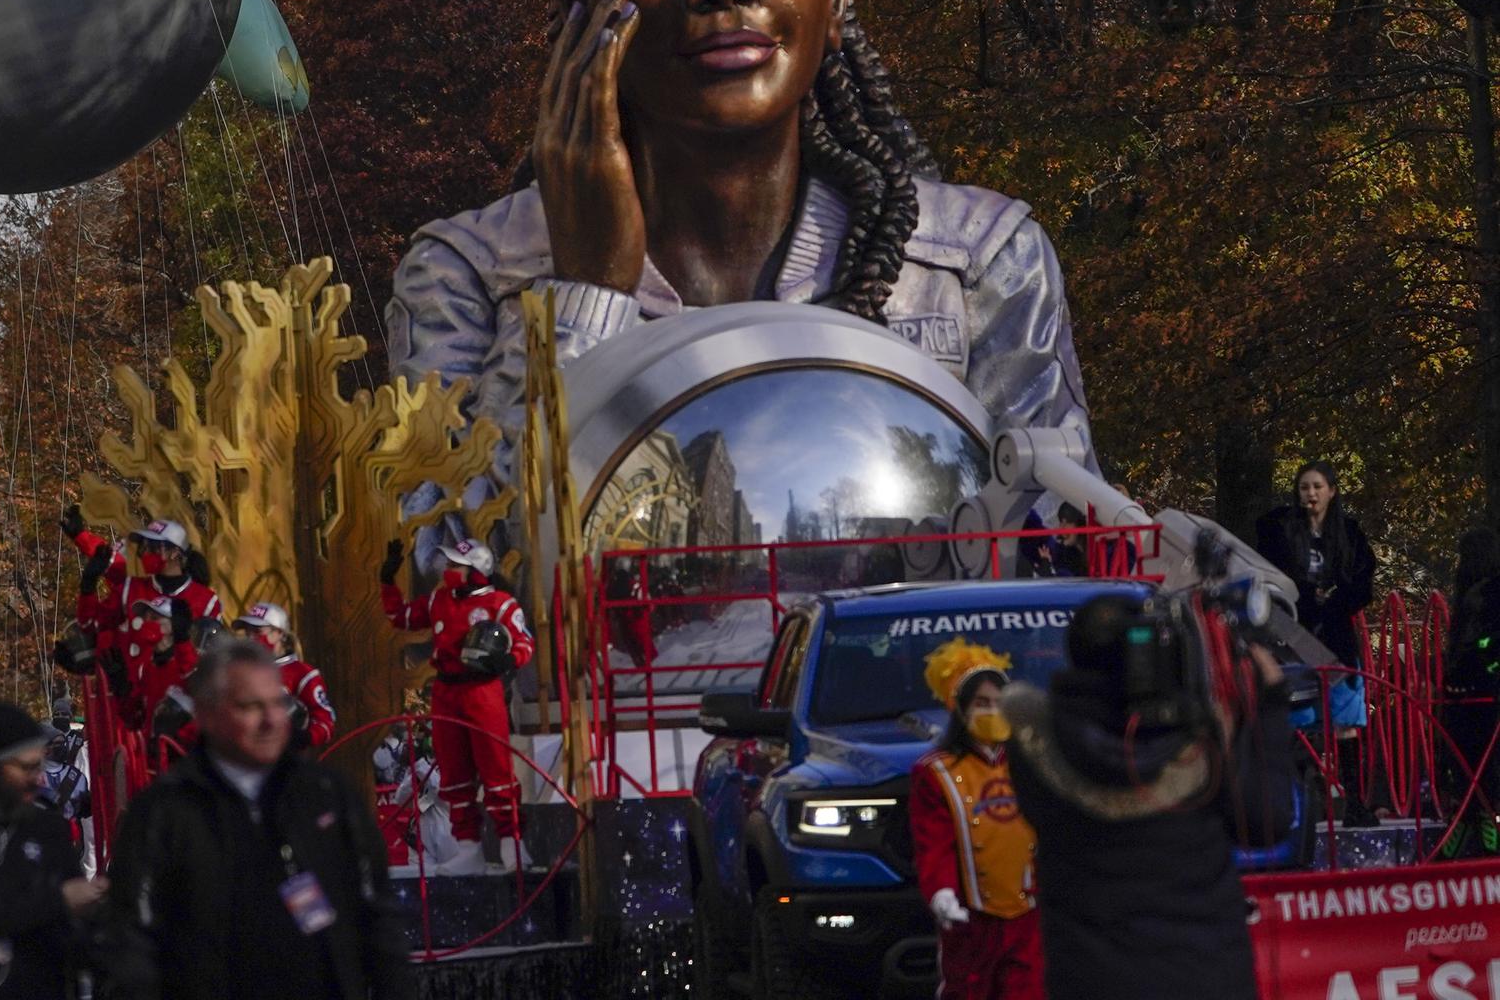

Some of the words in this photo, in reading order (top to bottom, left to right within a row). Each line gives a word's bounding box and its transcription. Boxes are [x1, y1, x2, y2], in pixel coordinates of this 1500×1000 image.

[889, 610, 1076, 637] #RAMTRUC
[1275, 876, 1500, 922] THANKSGIVIN
[1326, 961, 1500, 1000] AES
